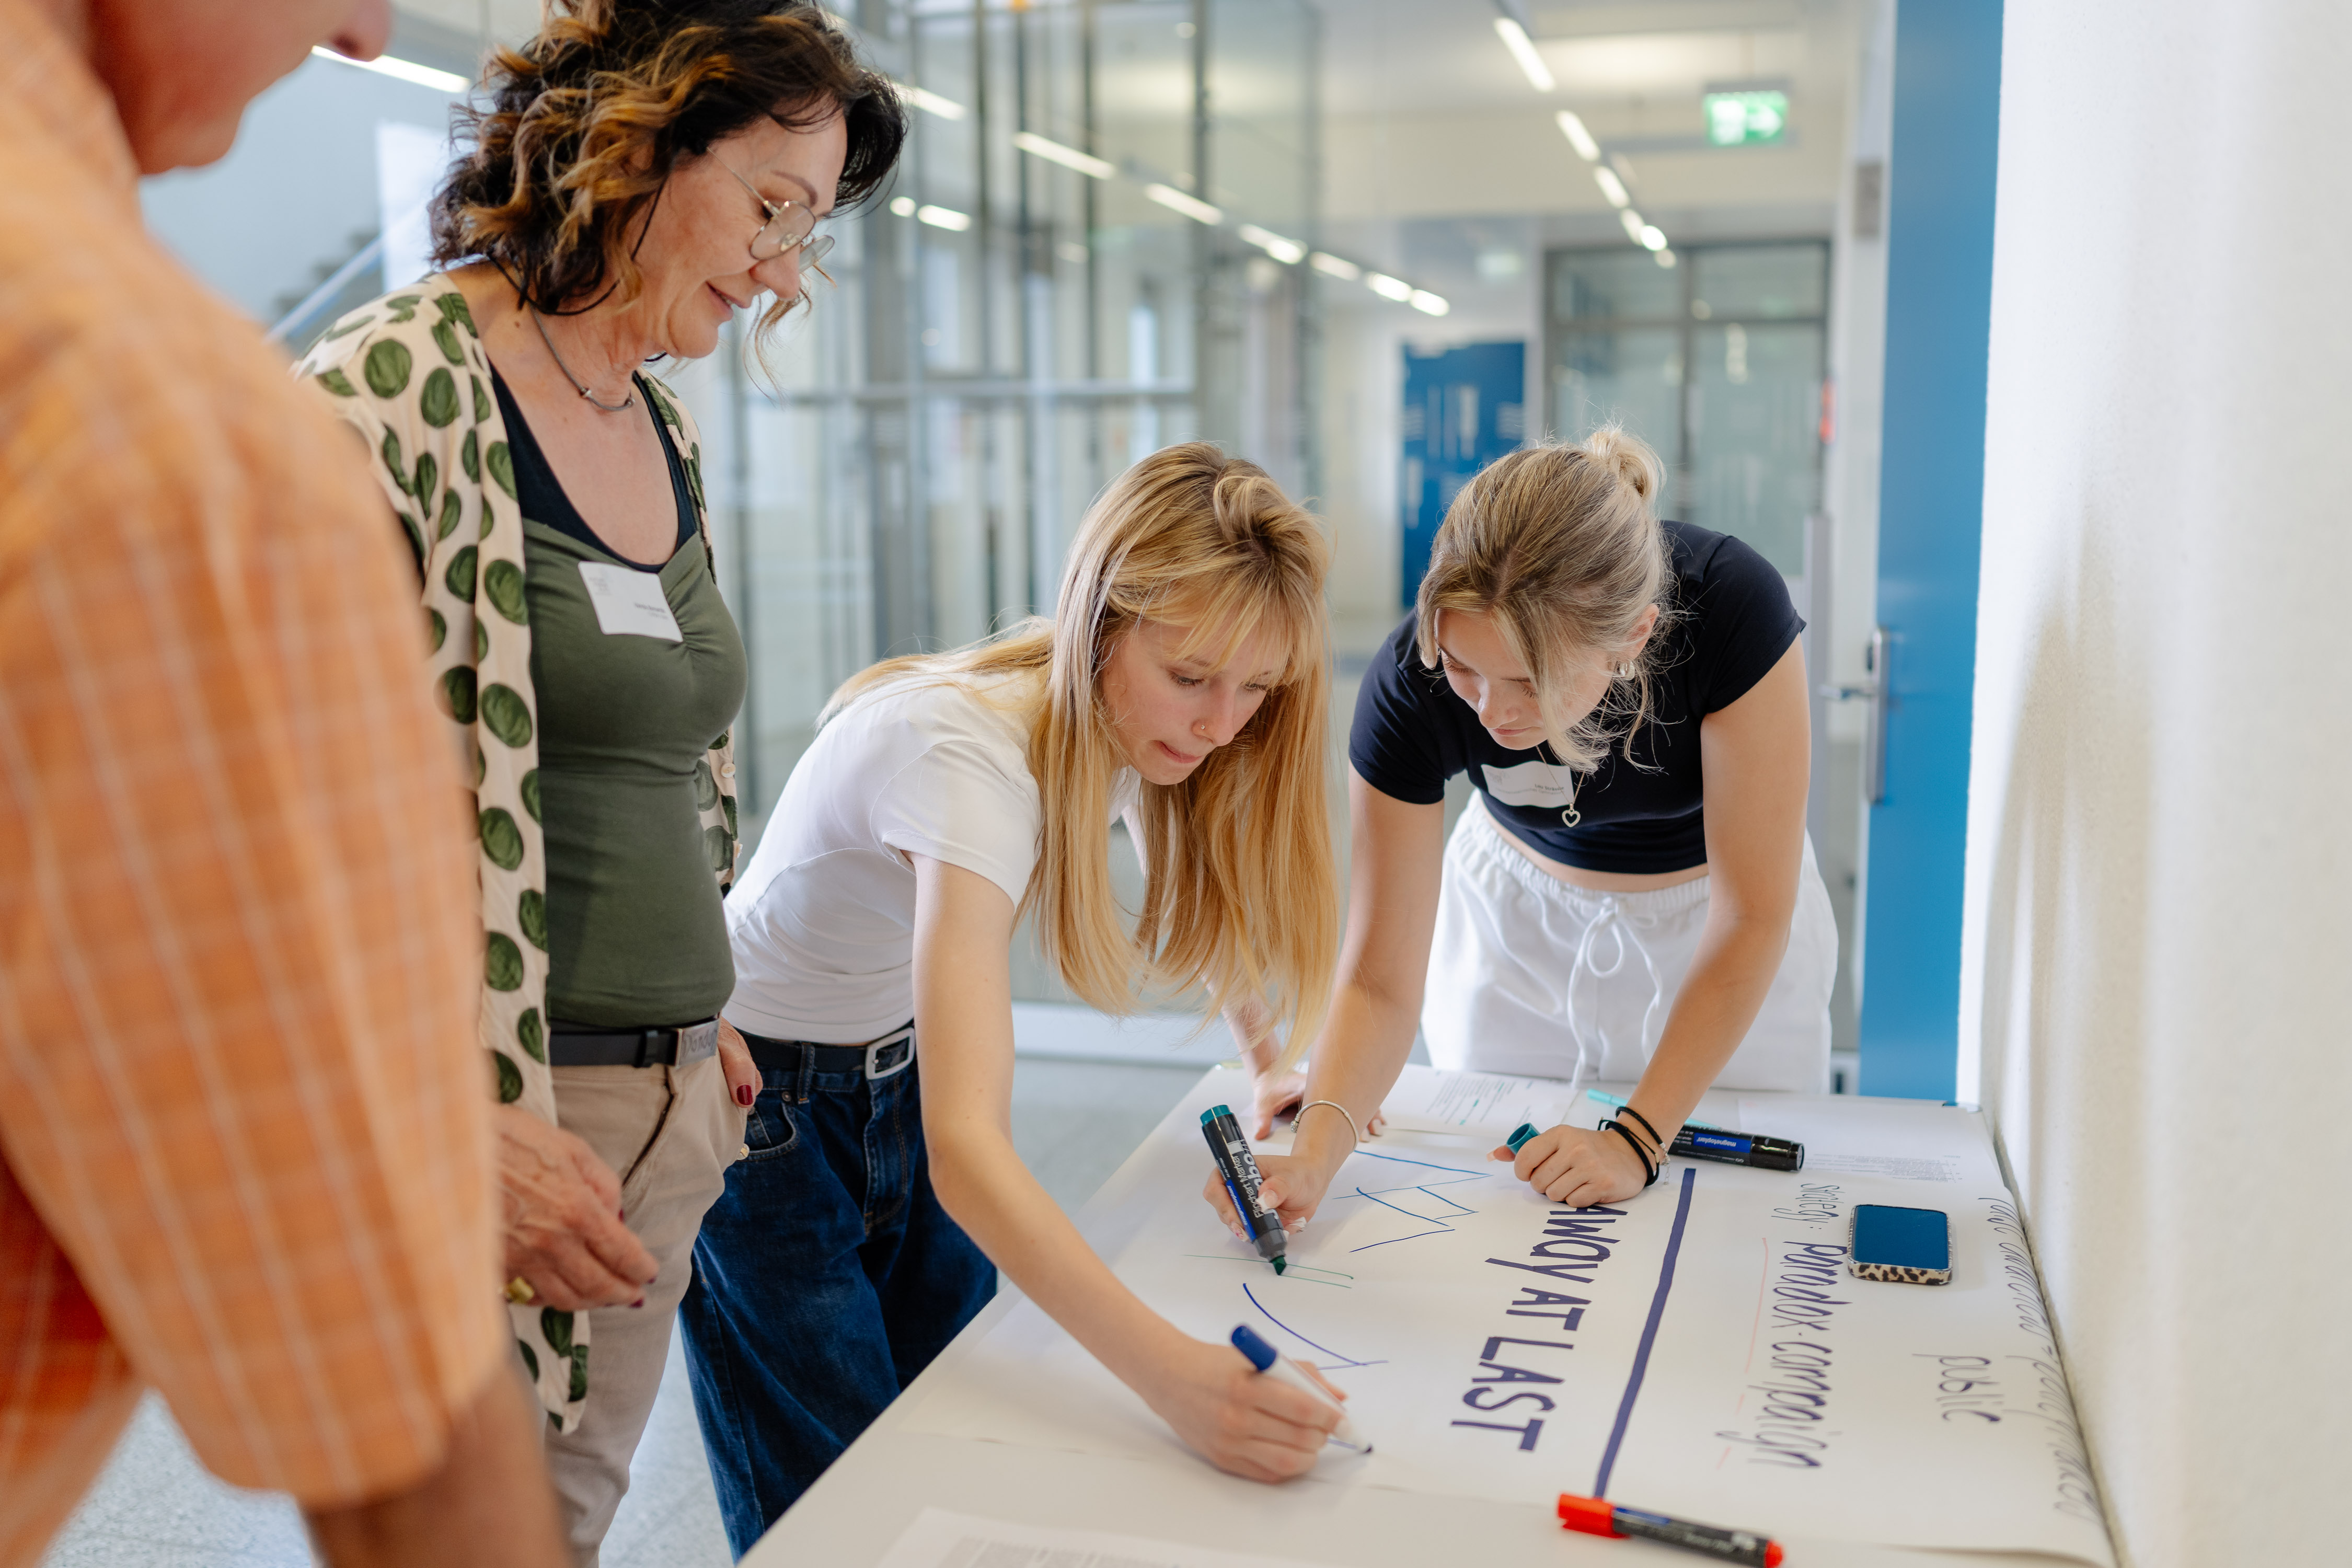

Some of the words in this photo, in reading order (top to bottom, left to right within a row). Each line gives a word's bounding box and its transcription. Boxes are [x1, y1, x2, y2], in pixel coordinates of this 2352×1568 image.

[1512, 1287, 1593, 1331] AT
[1450, 1336, 1575, 1452] LAST
[1911, 1353, 2005, 1423] public
